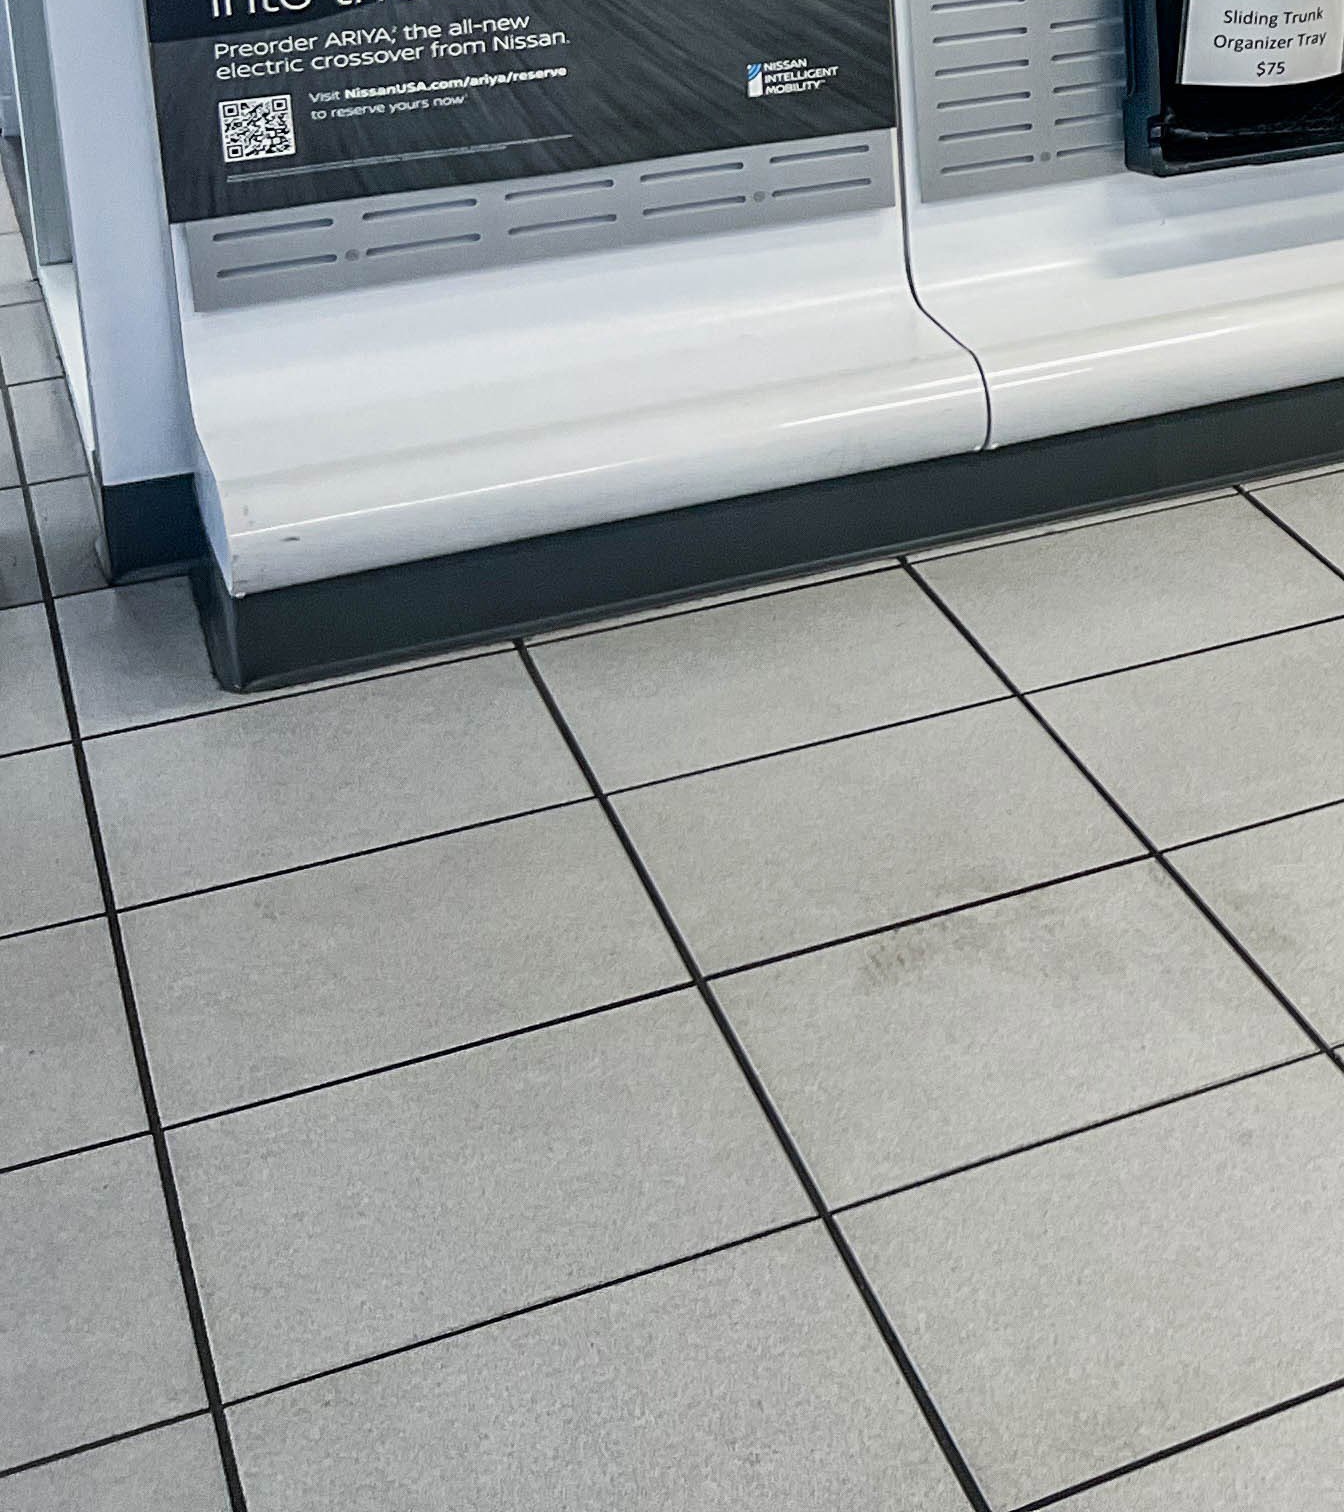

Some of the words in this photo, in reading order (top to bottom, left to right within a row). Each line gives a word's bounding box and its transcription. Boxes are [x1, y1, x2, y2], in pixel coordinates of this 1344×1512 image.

[1224, 9, 1278, 28] Sliding
[1284, 7, 1323, 24] Trunk
[213, 34, 318, 59] Preorder
[403, 23, 442, 40] the
[450, 16, 530, 37] all-new
[1214, 34, 1294, 52] Organizer
[1298, 31, 1327, 47] Tray
[216, 58, 304, 80] electric
[311, 48, 424, 71] crossover
[430, 40, 486, 59] from
[493, 31, 571, 51] Nissan.
[763, 58, 807, 71] NISSAN
[764, 66, 839, 84] INTELLIGENT
[1256, 61, 1286, 77] $75
[308, 91, 340, 103] Visit
[344, 66, 568, 100] NissanUSA.com/ariya/reserve
[311, 109, 327, 120] to
[331, 102, 385, 118] reserve
[388, 98, 430, 113] yours
